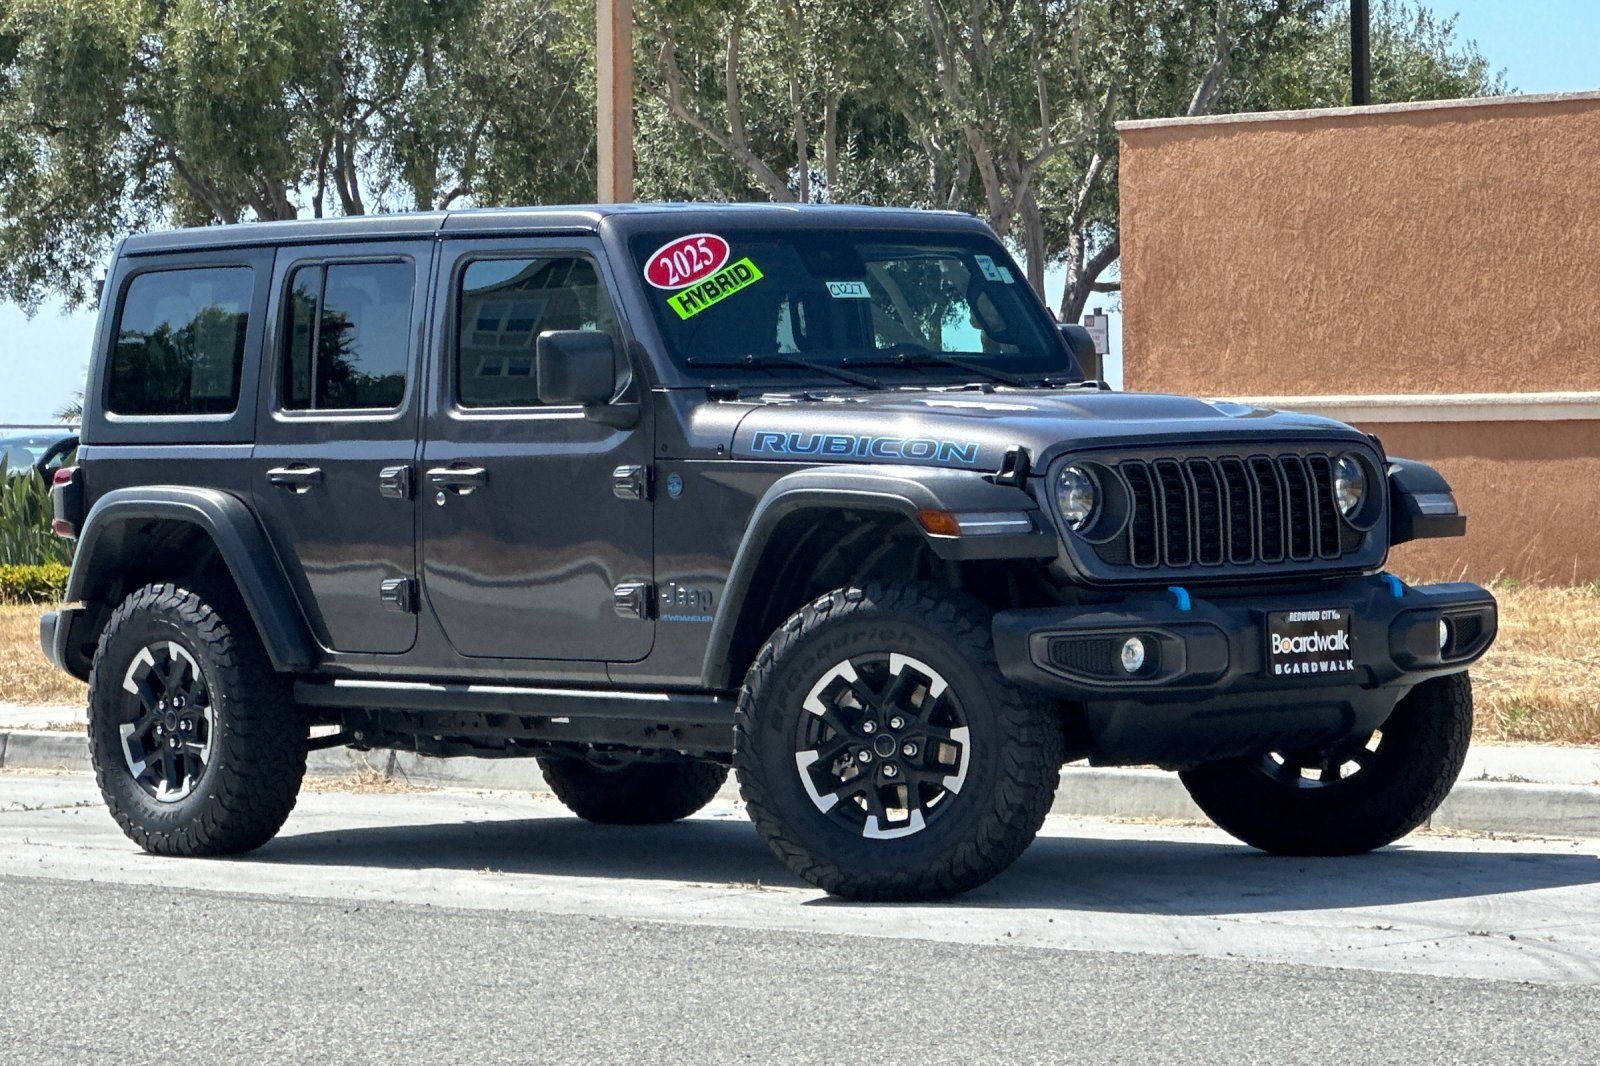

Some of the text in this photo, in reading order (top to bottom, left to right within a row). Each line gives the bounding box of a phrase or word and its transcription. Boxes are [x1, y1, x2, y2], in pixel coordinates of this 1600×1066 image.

[660, 238, 714, 285] 2025
[677, 264, 753, 313] HYBRID
[752, 431, 980, 463] RUBICON
[1289, 611, 1320, 622] REDWOOD
[1272, 630, 1350, 654] Boardwalk
[1275, 659, 1354, 675] BOARDWALK
